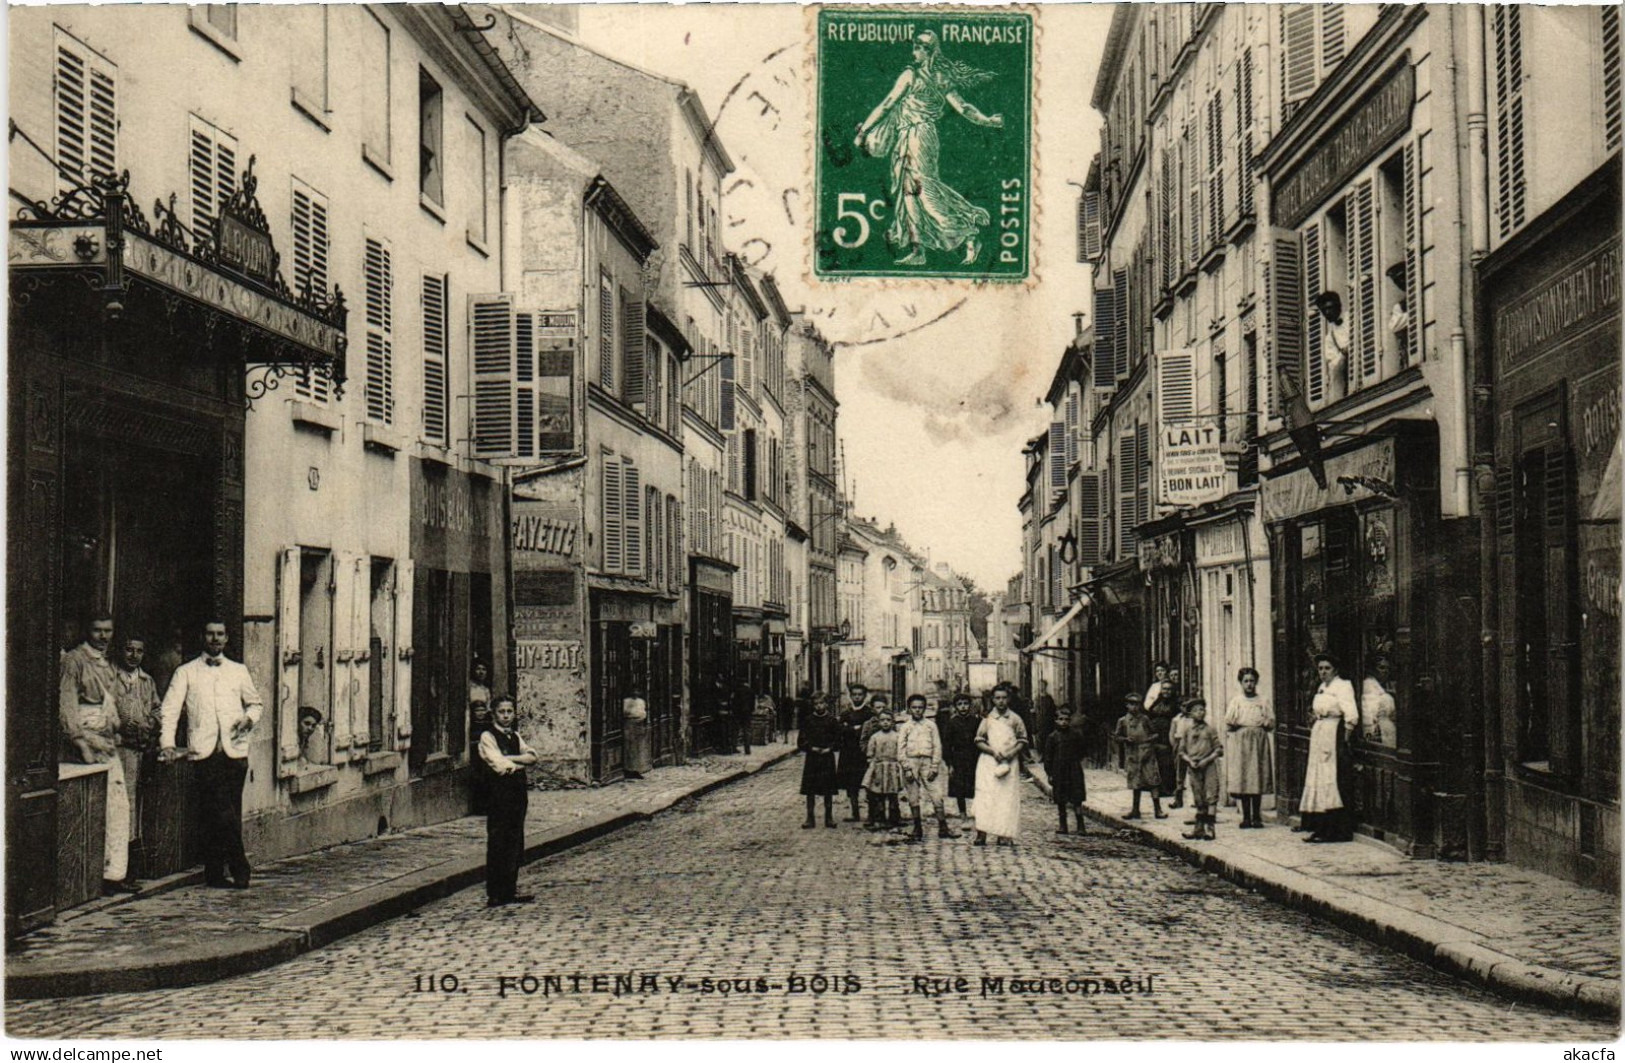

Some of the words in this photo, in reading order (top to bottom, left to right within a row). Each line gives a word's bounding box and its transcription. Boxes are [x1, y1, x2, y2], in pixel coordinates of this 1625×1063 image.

[828, 23, 915, 43] REPUBLIQUE
[942, 24, 1023, 45] FRANÇAISE
[1000, 178, 1021, 263] POSTES
[549, 315, 575, 328] MOULIN
[1167, 429, 1213, 447] LAIT
[1169, 478, 1192, 492] BON
[1196, 476, 1221, 490] LAIT
[510, 515, 578, 558] FAYETTE
